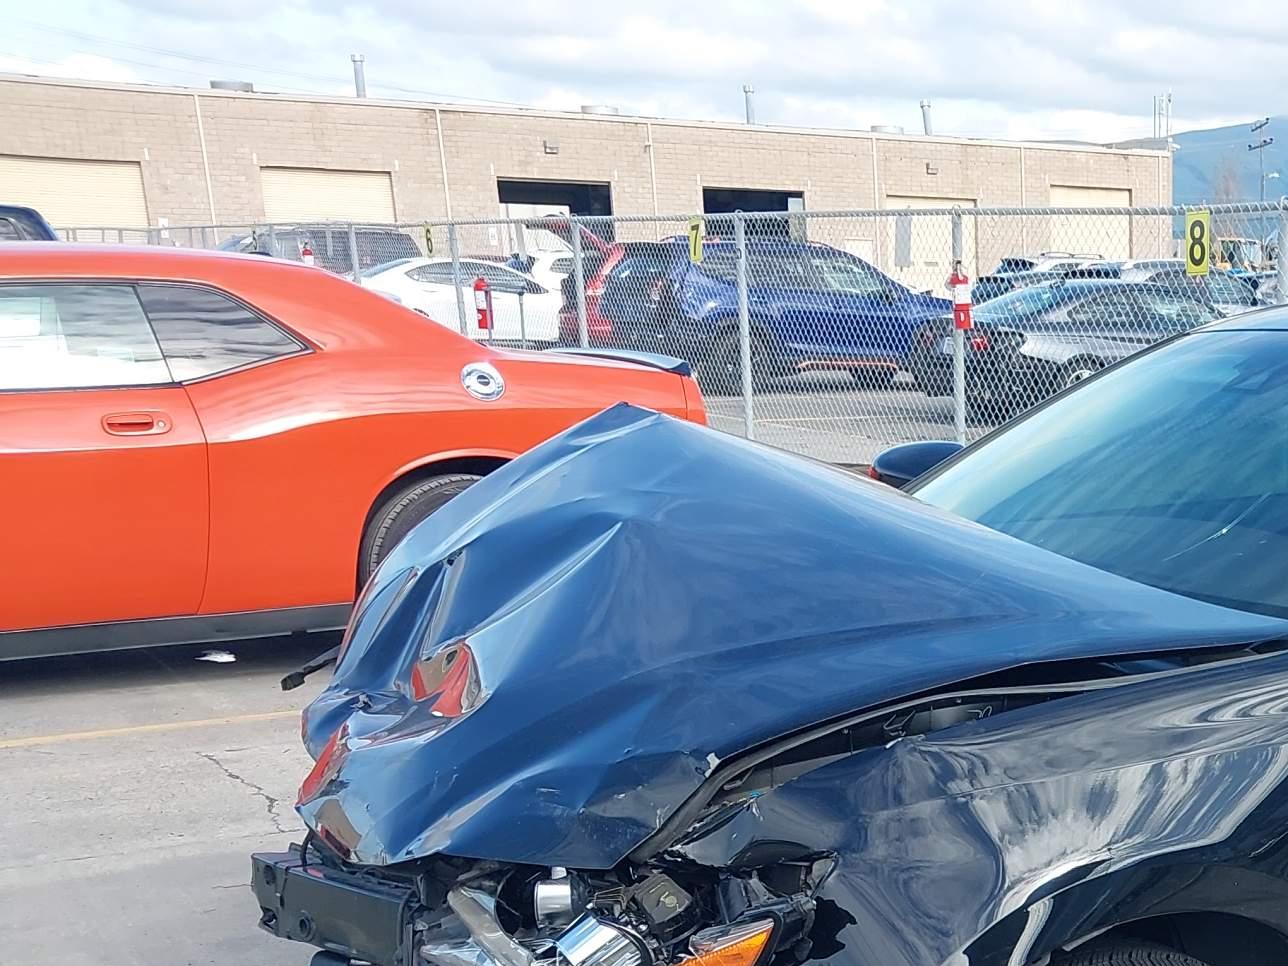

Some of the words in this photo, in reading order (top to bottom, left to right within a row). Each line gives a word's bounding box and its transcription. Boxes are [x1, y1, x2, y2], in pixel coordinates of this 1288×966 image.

[425, 228, 434, 254] 6
[690, 223, 700, 257] 7
[1189, 219, 1206, 267] 8
